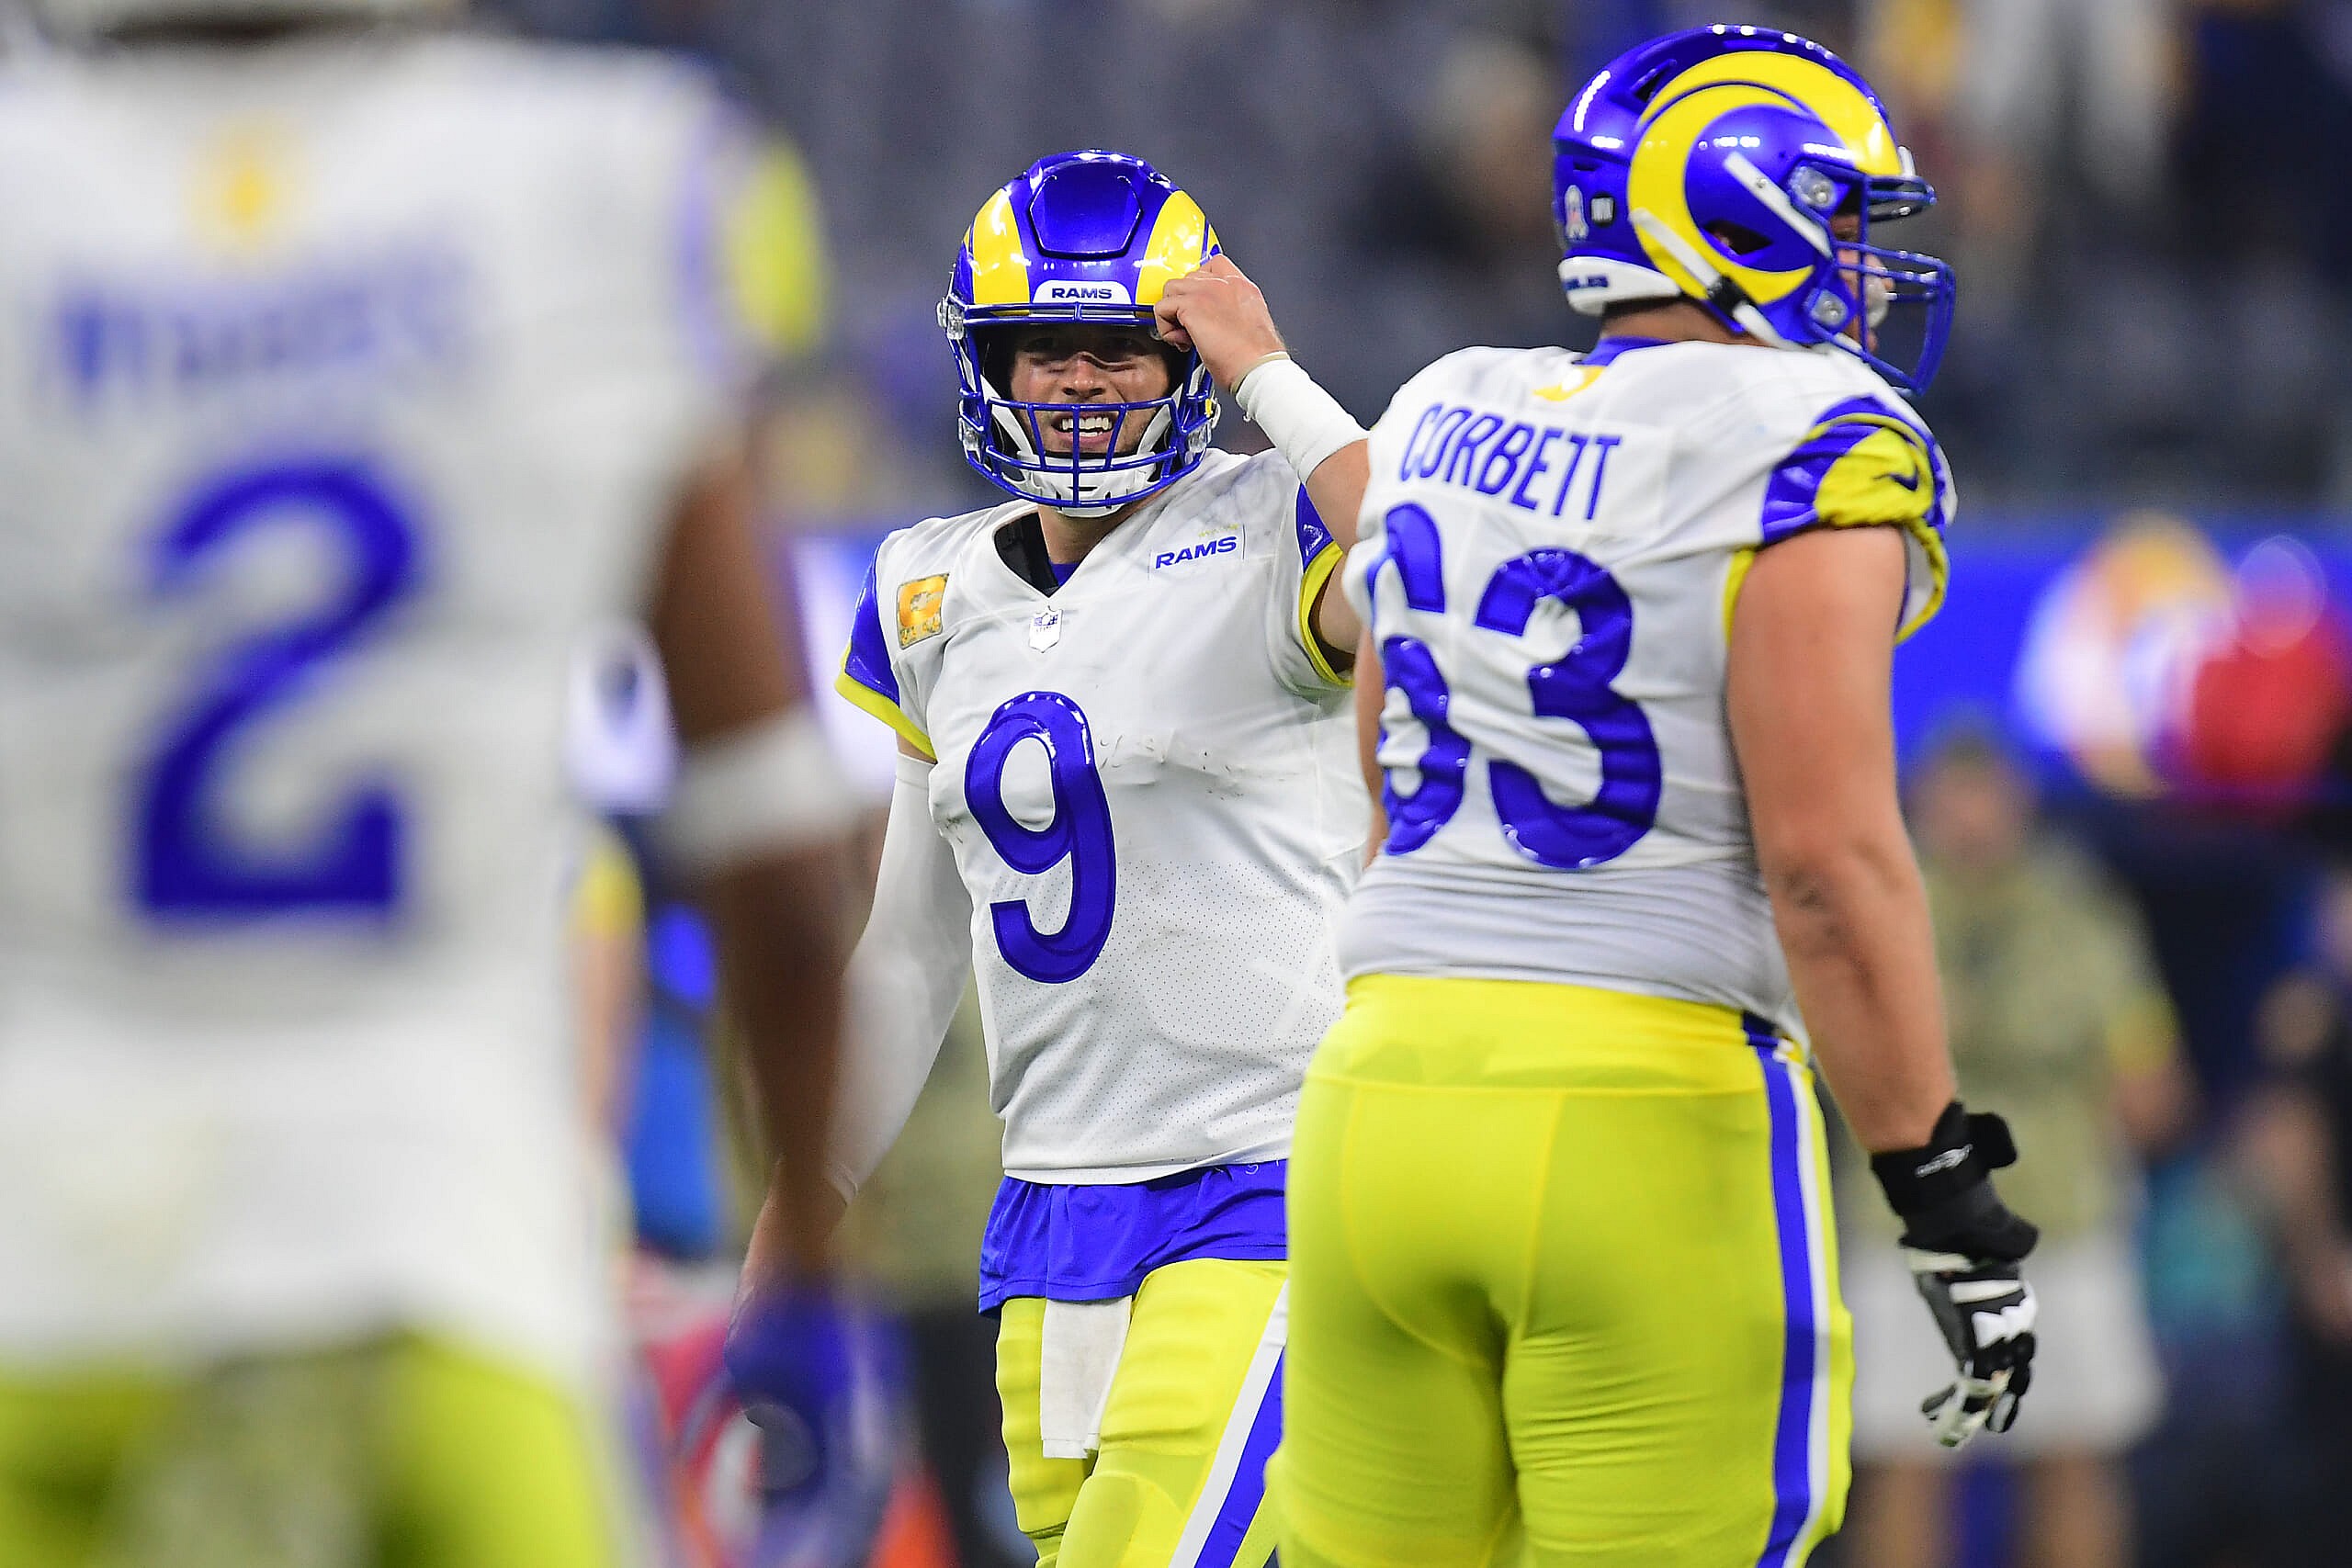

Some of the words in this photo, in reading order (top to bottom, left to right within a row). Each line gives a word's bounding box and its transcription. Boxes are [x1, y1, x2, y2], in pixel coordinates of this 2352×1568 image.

[1051, 288, 1113, 299] RAMS
[1155, 536, 1238, 570] RAMS
[1398, 401, 1623, 522] CORBETT
[138, 457, 418, 923] 2
[1366, 501, 1663, 871] 63
[964, 690, 1117, 985] 9
